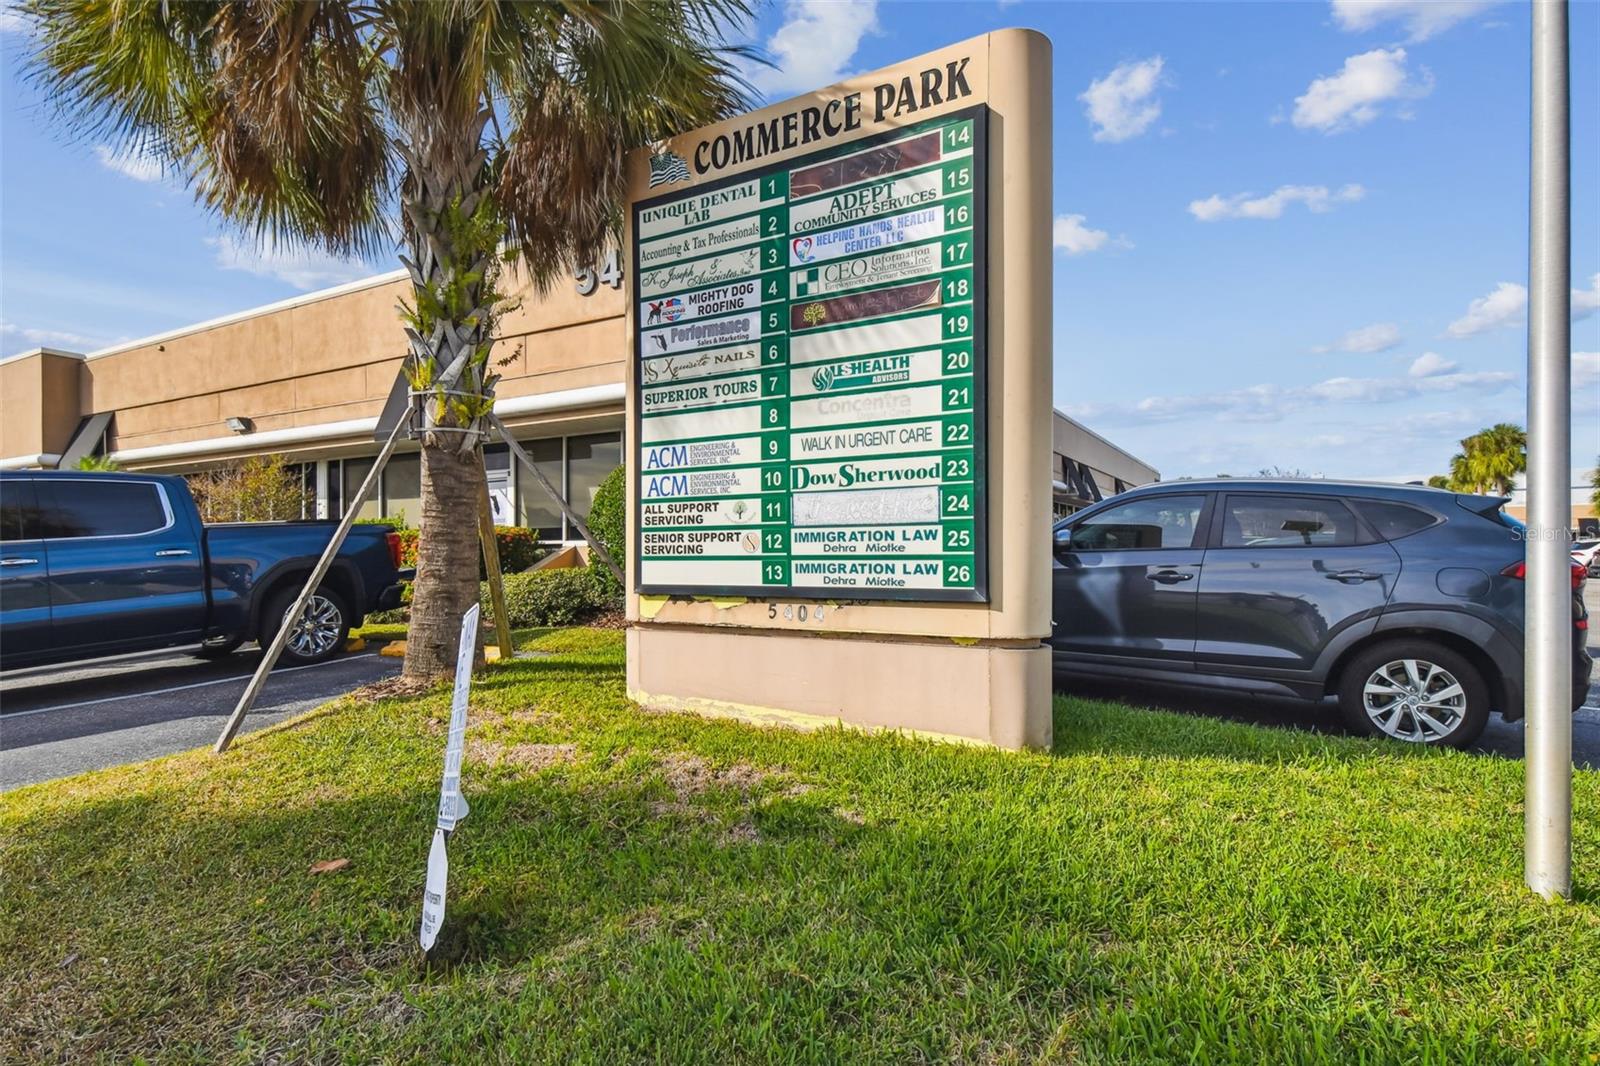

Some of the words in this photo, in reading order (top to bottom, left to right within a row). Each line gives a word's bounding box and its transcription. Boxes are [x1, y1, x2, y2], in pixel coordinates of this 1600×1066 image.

[694, 92, 861, 174] COMMERCE
[874, 57, 972, 123] PARK
[948, 126, 970, 146] 14
[948, 168, 969, 187] 15
[768, 180, 775, 194] 1
[642, 200, 696, 224] UNIQUE
[701, 185, 756, 208] DENTAL
[830, 182, 896, 213] ADEPT
[684, 209, 710, 226] LAB
[794, 206, 868, 232] COMMUNITY
[872, 188, 936, 212] SERVICES
[946, 206, 968, 224] 16
[768, 216, 776, 232] 2
[816, 230, 854, 246] HELPING
[898, 210, 935, 227] HEALTH
[641, 244, 682, 262] Accounting
[684, 240, 690, 251] &
[692, 236, 706, 248] Tax
[708, 223, 760, 244] Professionals
[844, 236, 881, 253] CENTER
[768, 250, 776, 264] 3
[946, 242, 968, 262] 17
[824, 259, 868, 282] CEO
[871, 247, 930, 265] Information
[660, 264, 694, 289] Joseph
[825, 278, 866, 291] Employment
[876, 272, 898, 280] Tenant
[688, 286, 728, 305] MIGHTY
[732, 283, 754, 297] DOG
[768, 281, 778, 296] 4
[946, 280, 968, 298] 18
[698, 298, 744, 316] ROOFING
[769, 313, 778, 328] 5
[946, 316, 968, 334] 19
[670, 318, 750, 343] Performance
[698, 338, 712, 347] Sales
[719, 334, 750, 344] Marketing
[714, 350, 755, 364] NAILS
[769, 346, 778, 360] 6
[947, 352, 968, 370] 20
[770, 377, 778, 392] 7
[872, 373, 908, 384] ADVISORS
[645, 388, 708, 405] SUPERIOR
[714, 380, 758, 396] TOURS
[948, 388, 968, 406] 21
[818, 393, 911, 415] Concentra
[769, 408, 778, 424] 8
[801, 436, 832, 452] WALK
[834, 434, 846, 449] IN
[848, 430, 896, 448] URGENT
[900, 427, 932, 444] CARE
[947, 424, 968, 442] 22
[690, 442, 730, 450] ENGINEERING
[731, 441, 736, 449] &
[769, 440, 778, 455] 9
[647, 446, 688, 469] ACM
[690, 449, 740, 460] ENVIRONMENTAL
[947, 460, 968, 476] 23
[690, 473, 730, 481] ENGINEERING
[690, 479, 741, 488] ENVIRONMENTAL
[764, 472, 782, 486] 10
[791, 467, 837, 490] Dow
[839, 463, 940, 487] Sherwood
[648, 474, 688, 497] ACM
[644, 505, 664, 514] ALL
[668, 502, 720, 514] SUPPORT
[766, 502, 781, 518] 11
[947, 496, 969, 512] 24
[644, 515, 704, 526] SERVICING
[644, 534, 684, 544] SENIOR
[688, 532, 742, 542] SUPPORT
[765, 534, 782, 549] 12
[794, 530, 895, 542] IMMIGRATION
[902, 530, 938, 541] LAW
[948, 530, 970, 546] 25
[644, 545, 704, 554] SERVICING
[823, 543, 856, 552] Dehra
[865, 543, 906, 552] Miotke
[766, 565, 783, 580] 13
[795, 563, 895, 574] IMMIGRATION
[903, 564, 938, 574] LAW
[948, 566, 970, 582] 26
[823, 576, 856, 585] Dehra
[865, 577, 906, 586] Miotke
